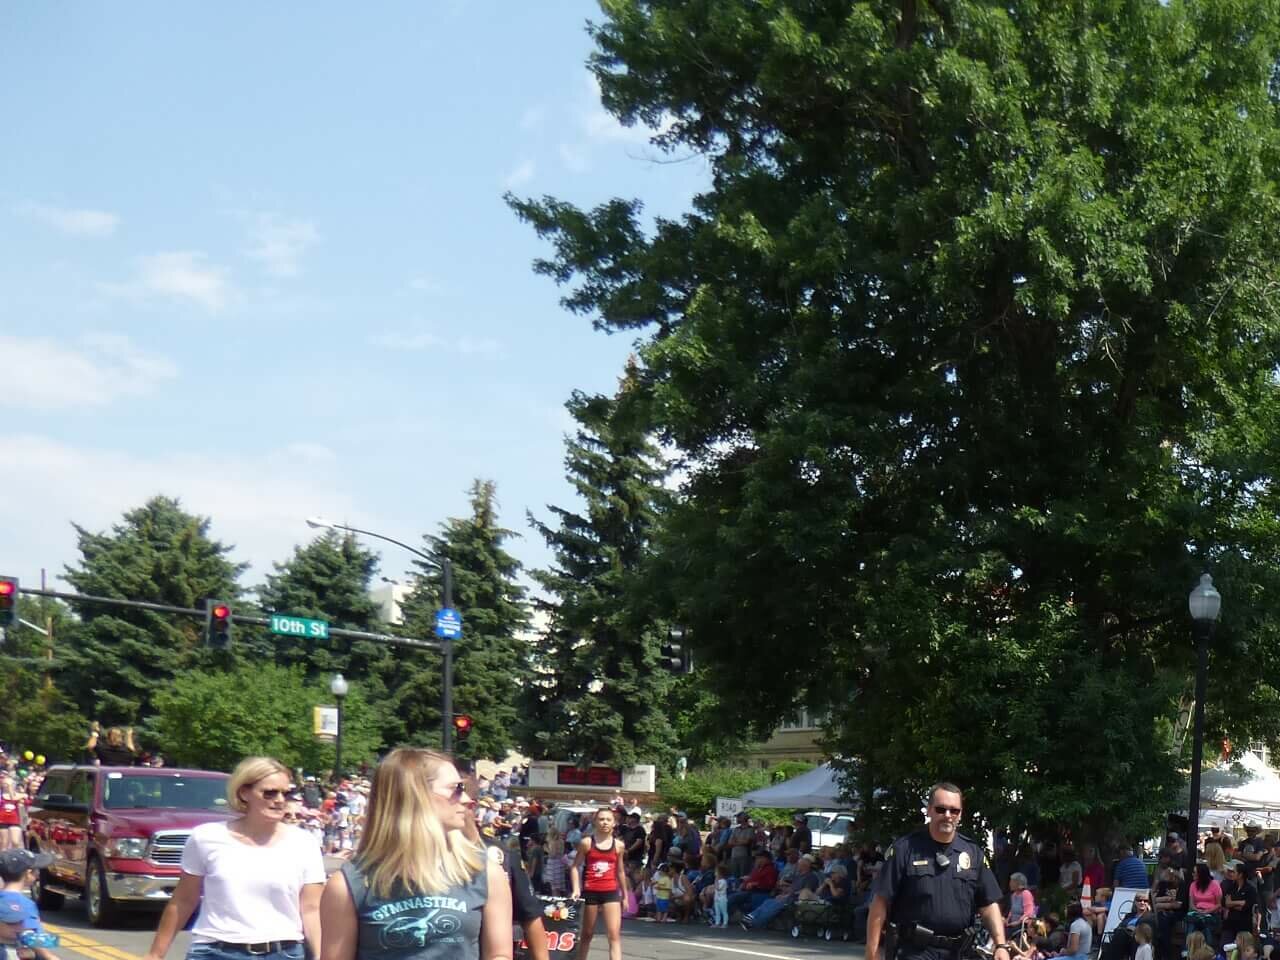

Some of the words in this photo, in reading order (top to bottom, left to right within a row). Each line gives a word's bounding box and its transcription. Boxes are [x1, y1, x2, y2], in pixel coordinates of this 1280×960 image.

[273, 618, 306, 634] 10th
[310, 622, 326, 637] St
[372, 896, 467, 921] GYMNASTIKA
